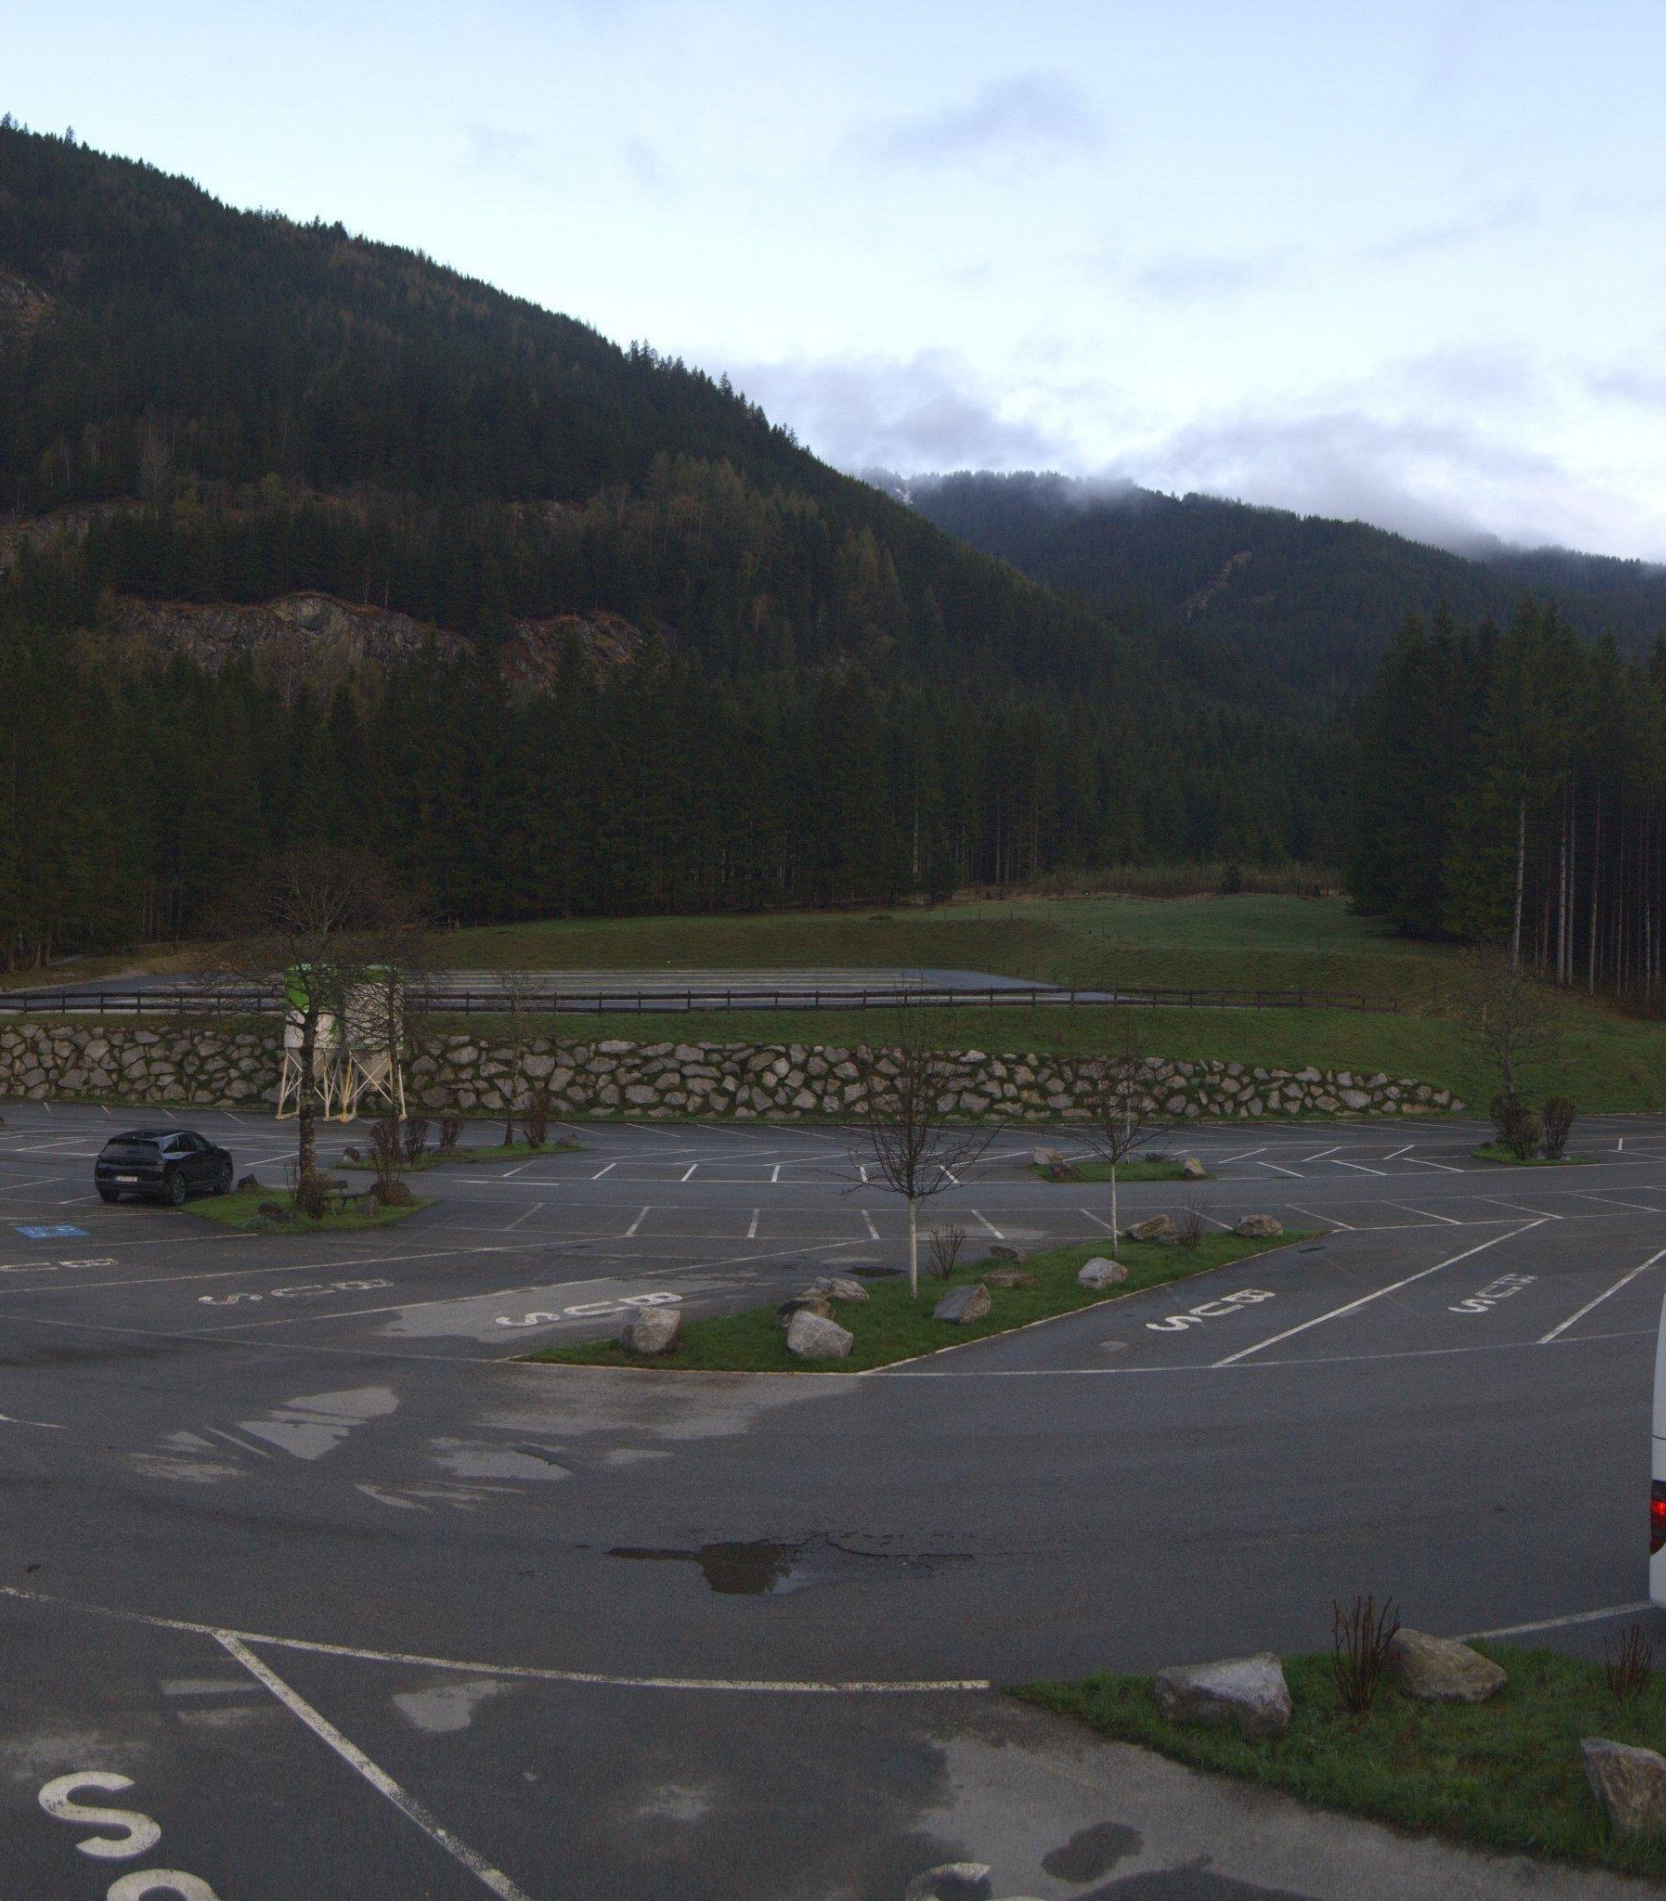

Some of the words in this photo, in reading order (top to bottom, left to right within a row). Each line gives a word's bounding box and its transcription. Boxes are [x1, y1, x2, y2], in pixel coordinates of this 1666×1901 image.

[198, 1278, 395, 1306] BUS
[495, 1291, 683, 1326] BUS
[1145, 1288, 1276, 1331] BUS
